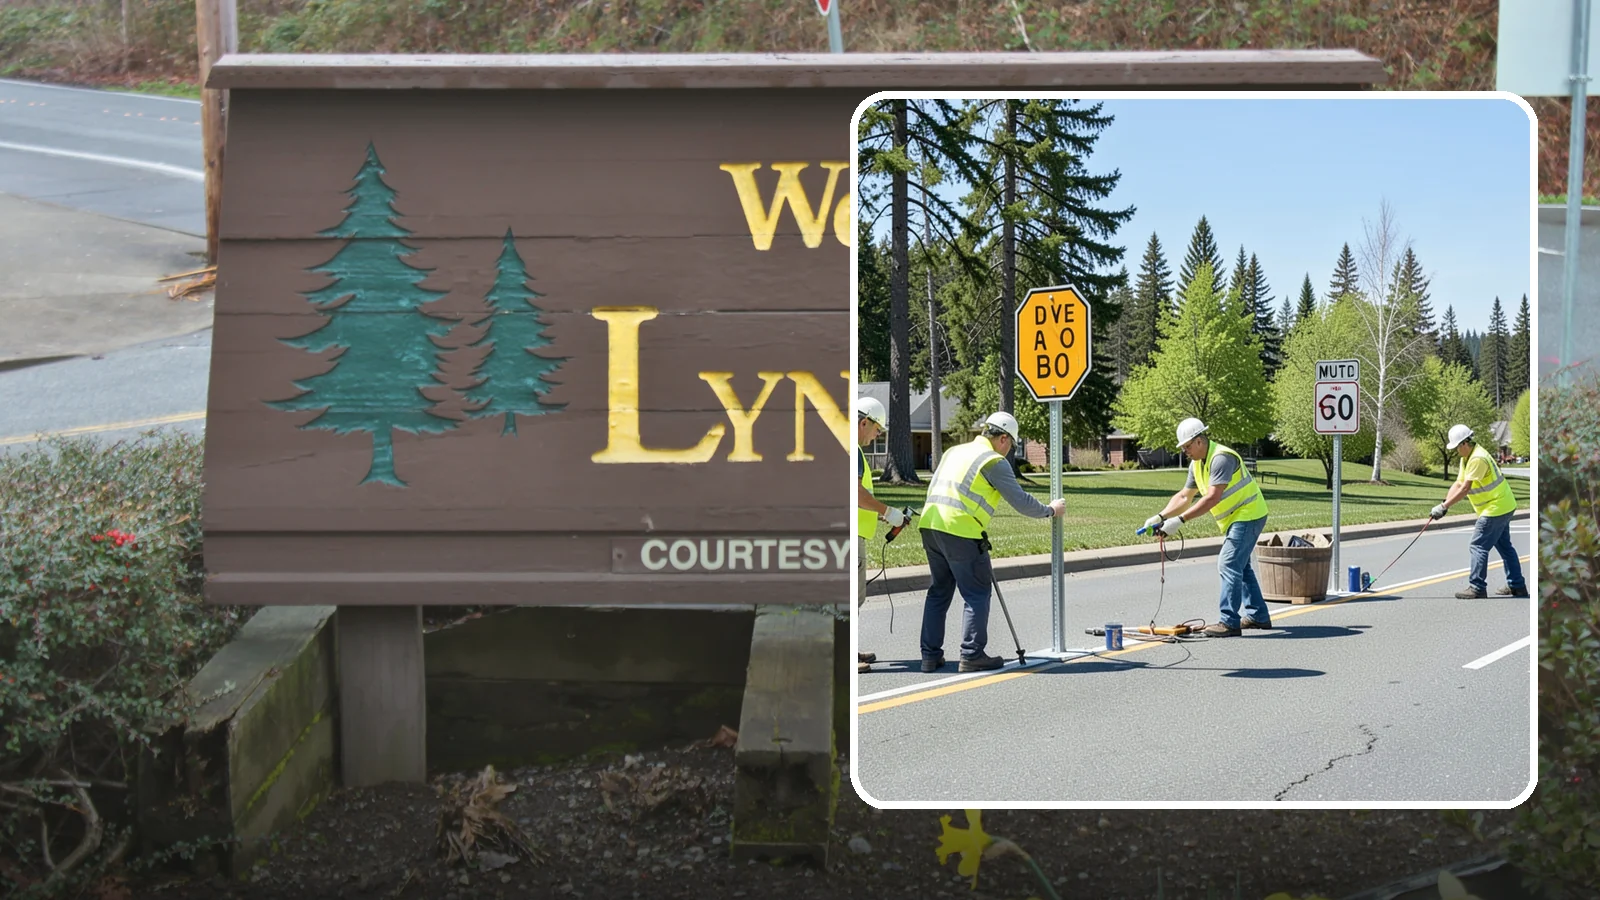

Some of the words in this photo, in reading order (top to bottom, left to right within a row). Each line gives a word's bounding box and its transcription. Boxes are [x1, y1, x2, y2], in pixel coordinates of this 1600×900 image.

[1037, 352, 1070, 379] BO
[1319, 394, 1354, 421] 60
[640, 539, 850, 570] COURTESY
